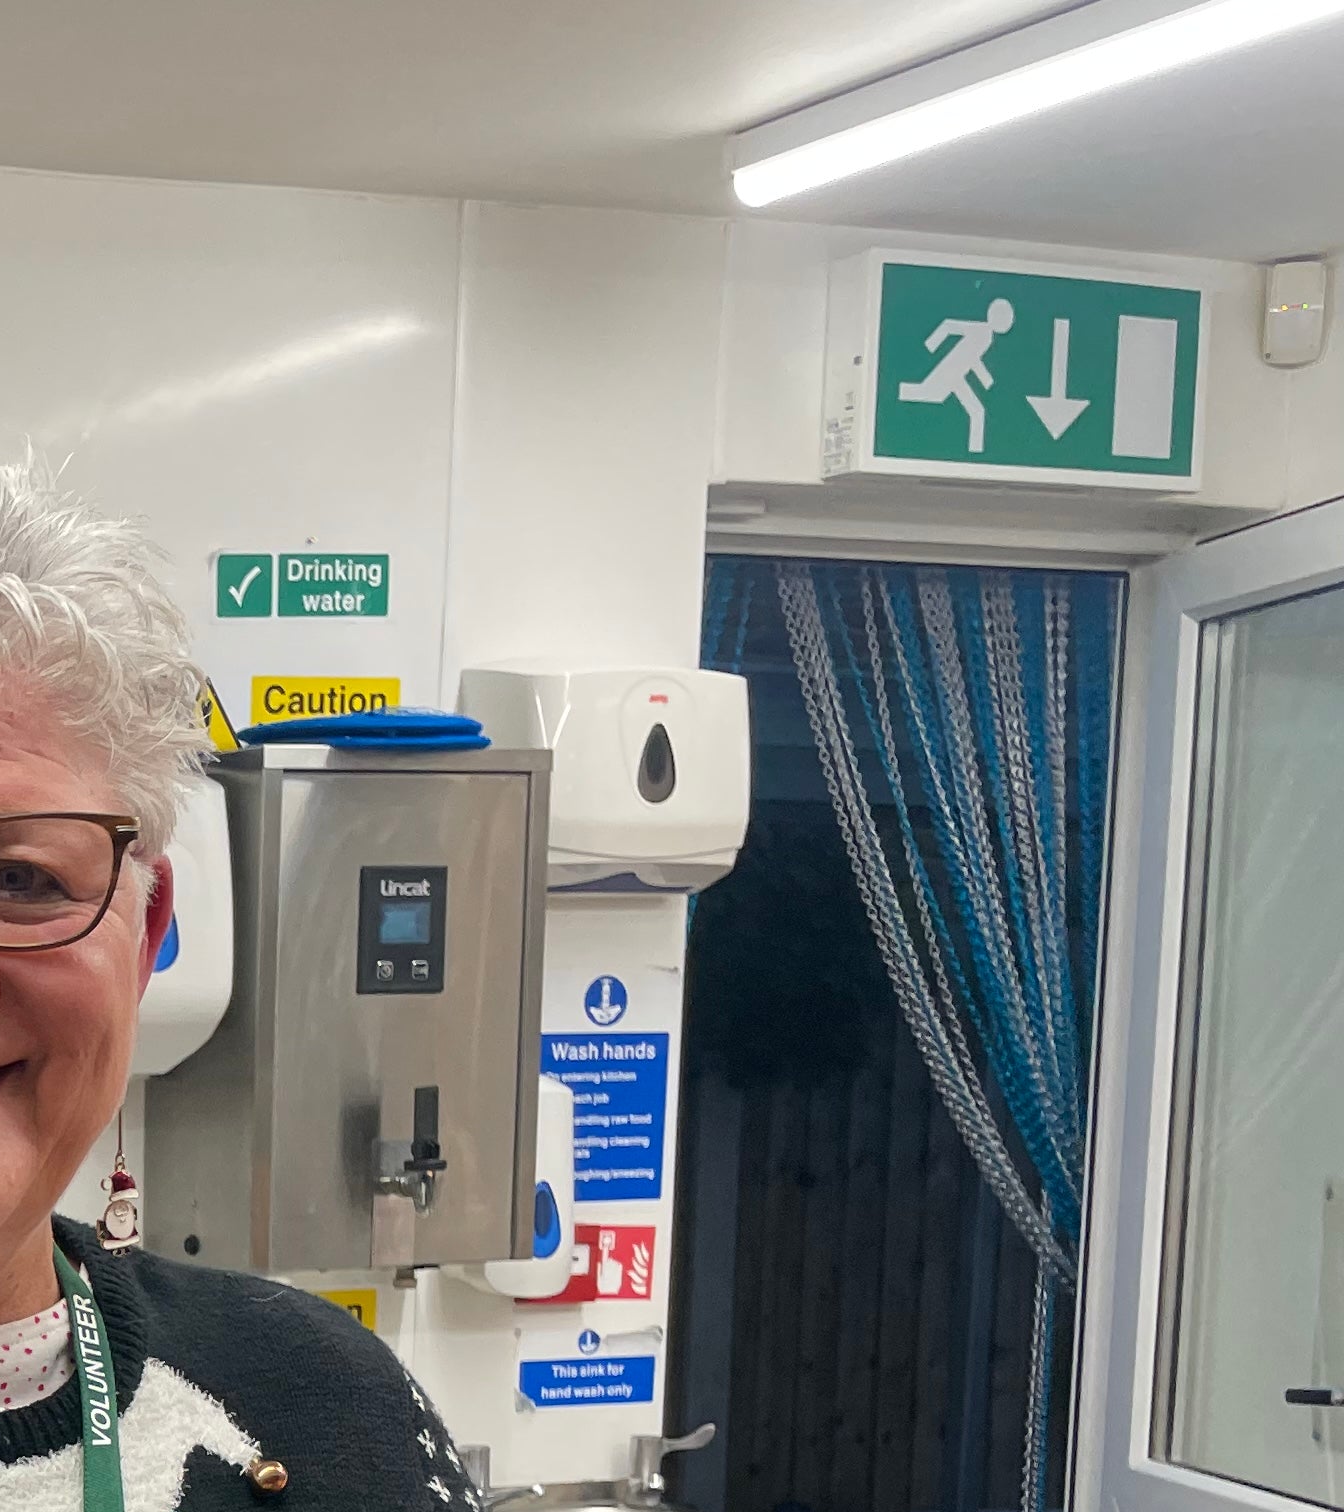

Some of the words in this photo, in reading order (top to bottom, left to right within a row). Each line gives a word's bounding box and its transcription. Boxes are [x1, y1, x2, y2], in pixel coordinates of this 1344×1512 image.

[287, 559, 382, 587] Drinking
[302, 590, 365, 612] water
[264, 685, 387, 714] Caution
[551, 1041, 599, 1061] Wash
[603, 1041, 656, 1061] hands
[72, 1293, 111, 1446] VOLUNTEER
[551, 1364, 578, 1378] This
[580, 1363, 606, 1378] sink
[607, 1362, 624, 1376] for
[541, 1385, 572, 1399] hand
[573, 1384, 605, 1398] wash
[607, 1383, 633, 1398] only
